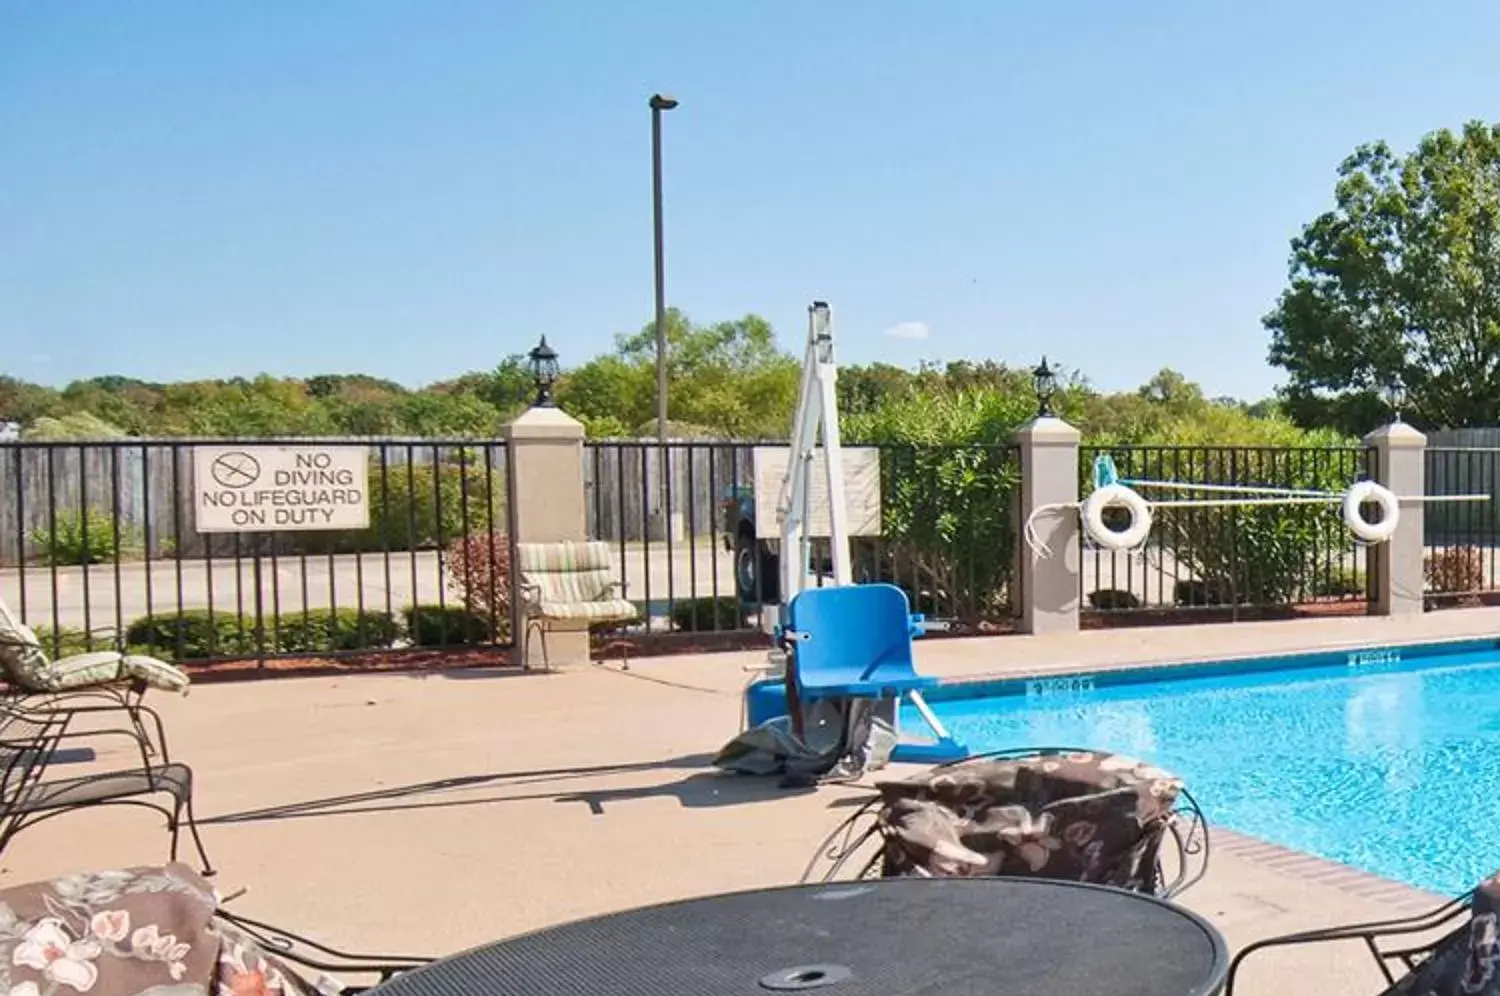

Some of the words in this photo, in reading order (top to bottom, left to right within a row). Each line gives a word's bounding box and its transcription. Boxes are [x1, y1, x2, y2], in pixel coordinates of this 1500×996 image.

[296, 453, 331, 469] NO
[275, 469, 353, 486] DIVING
[203, 490, 237, 507] NO
[241, 489, 362, 506] LIFEGUARD
[231, 509, 265, 525] ON
[275, 508, 335, 525] DUTY
